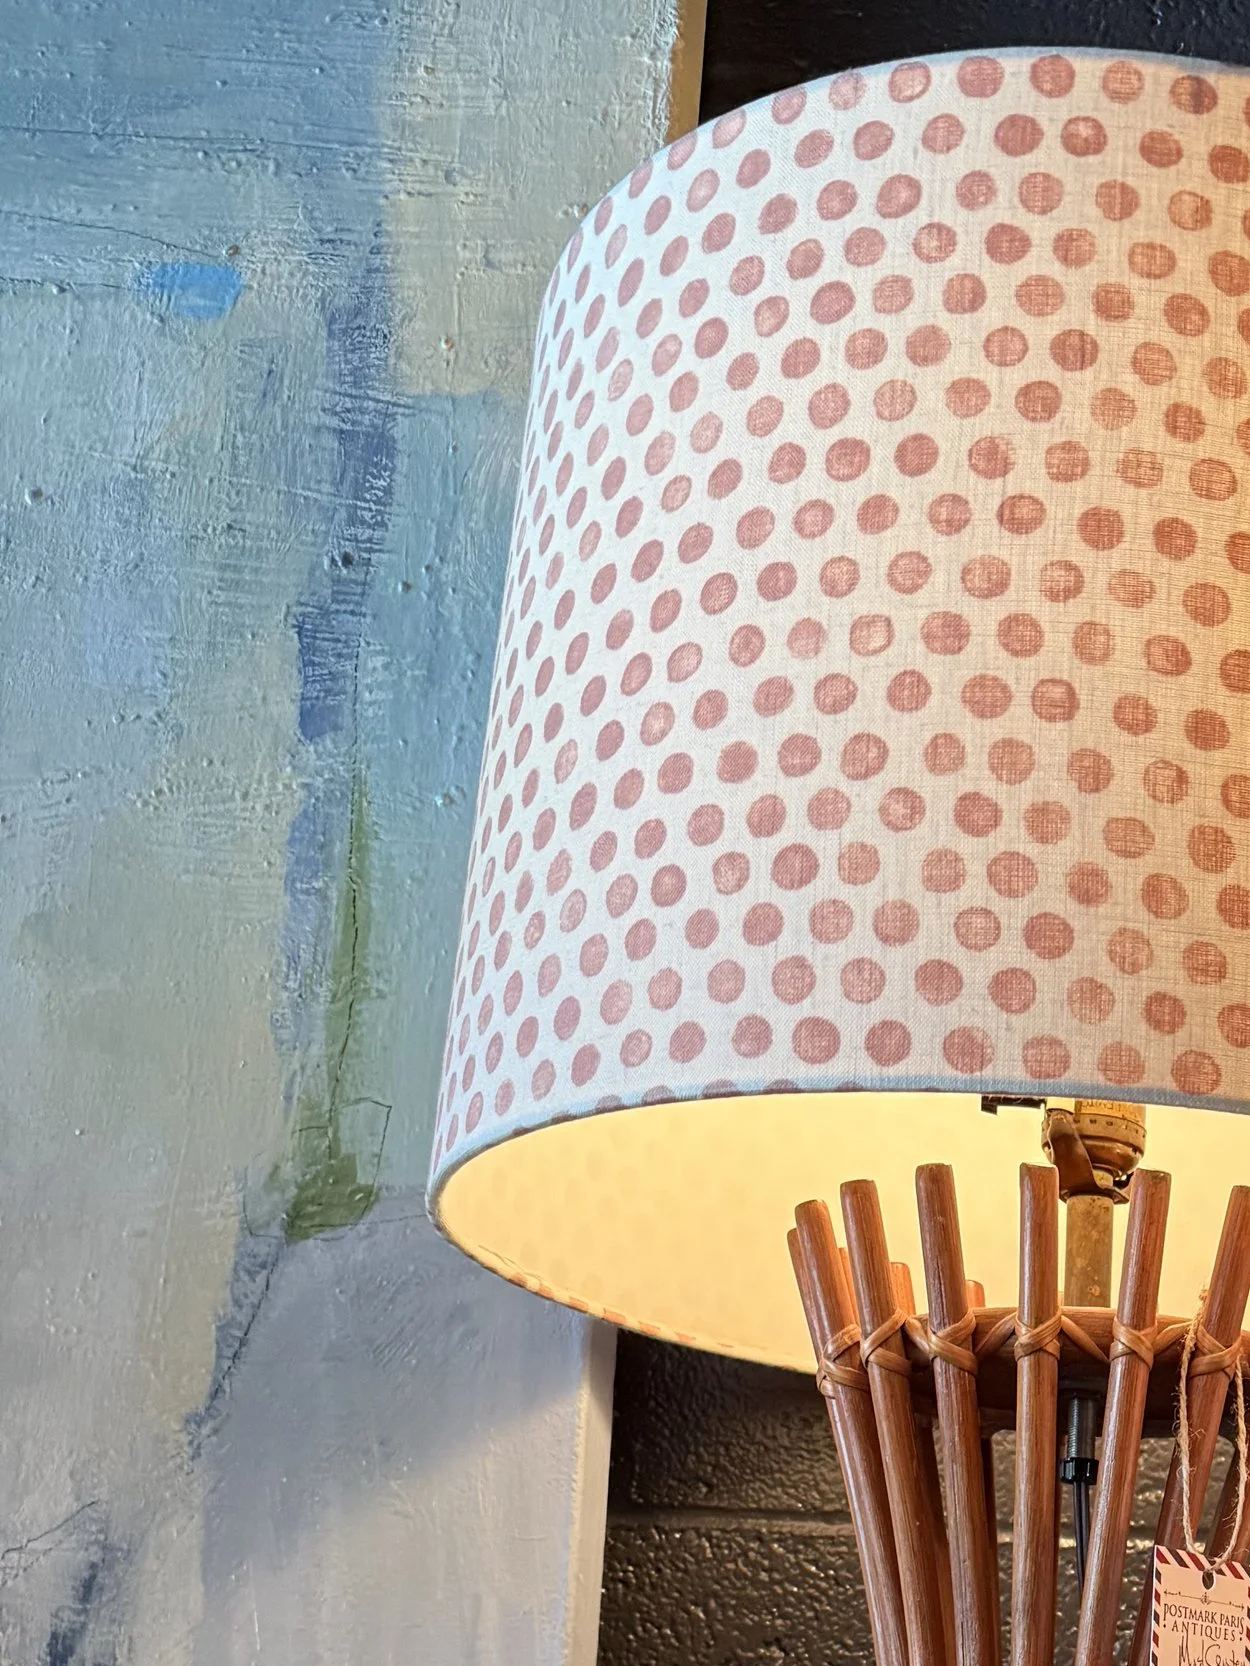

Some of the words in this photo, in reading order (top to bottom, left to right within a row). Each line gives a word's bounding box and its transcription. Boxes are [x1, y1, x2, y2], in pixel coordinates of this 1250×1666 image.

[1163, 1603, 1217, 1626] POSTMARK
[1219, 1614, 1245, 1635] PARIS
[1171, 1621, 1236, 1642] ANTIQUES
